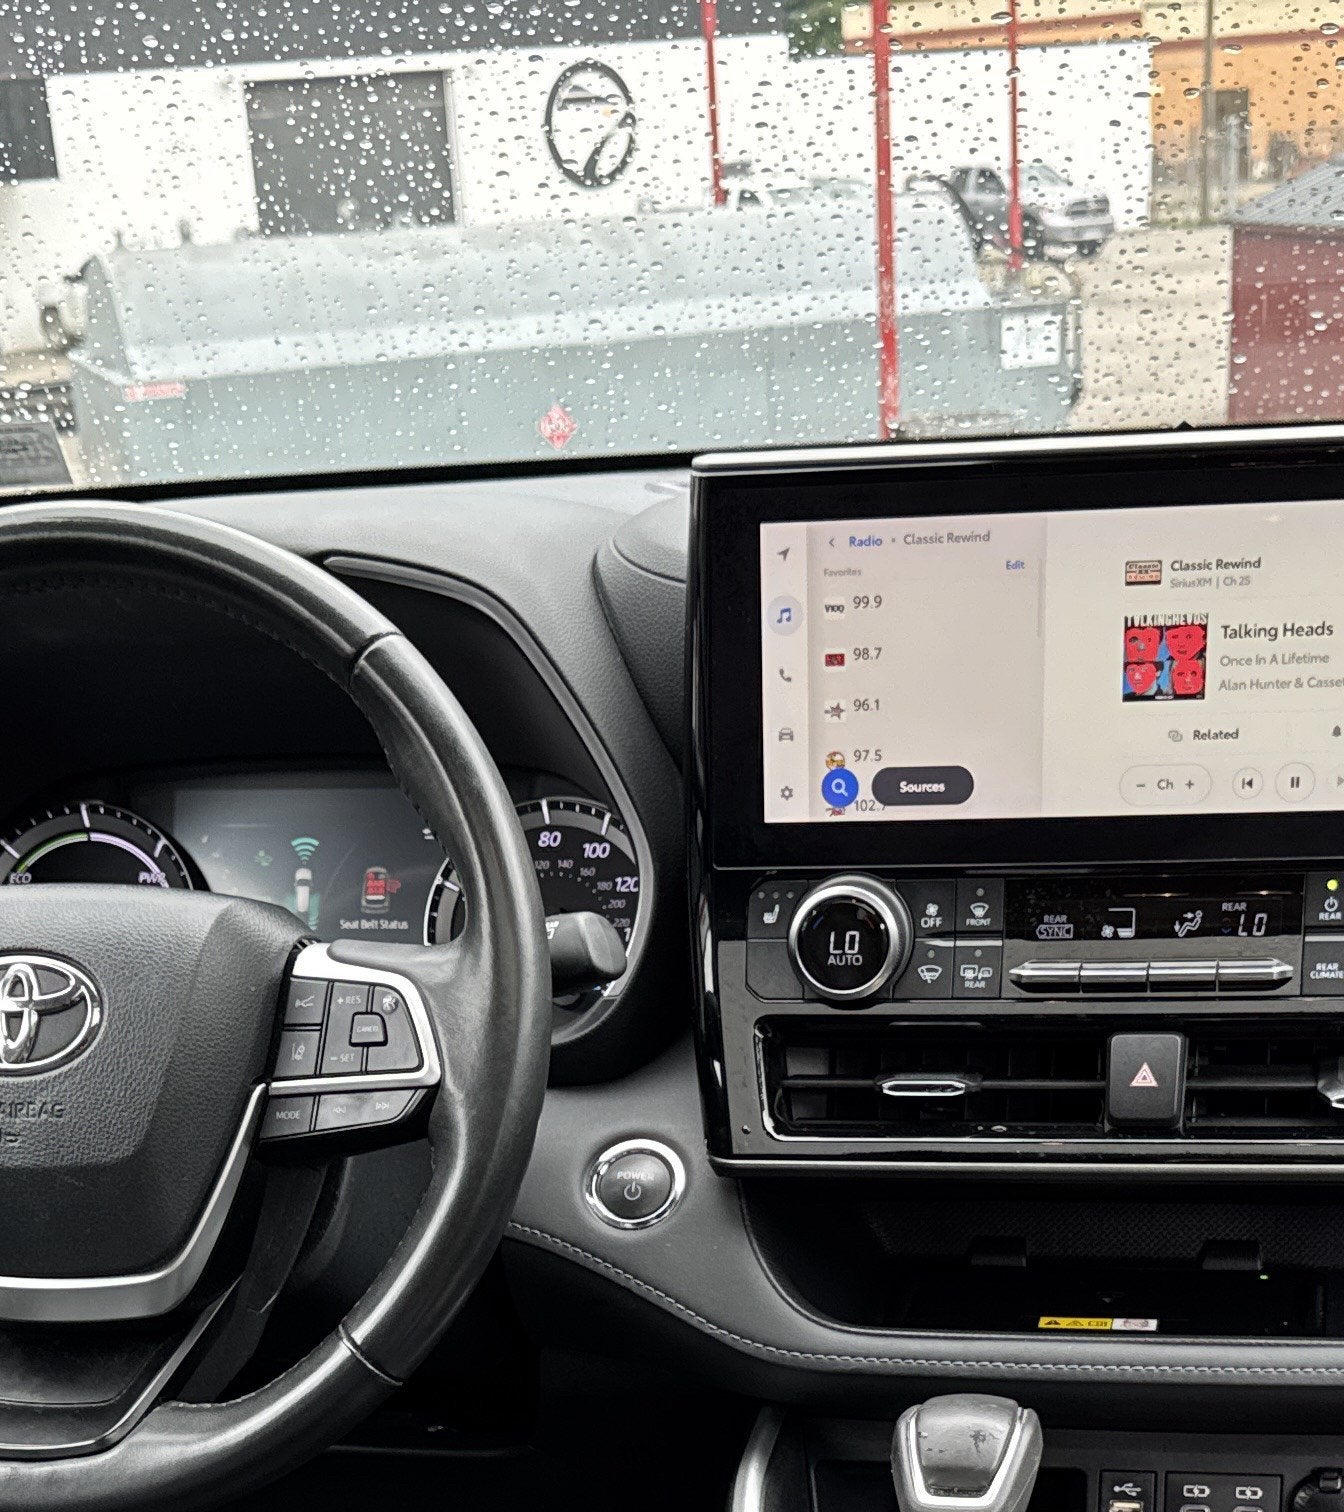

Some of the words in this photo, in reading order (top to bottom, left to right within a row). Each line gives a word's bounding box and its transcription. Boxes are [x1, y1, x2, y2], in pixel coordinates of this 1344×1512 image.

[849, 536, 882, 547] Radio
[903, 533, 944, 546] Classic
[947, 531, 991, 543] Rewind
[1006, 560, 1025, 570] Edit
[1170, 559, 1213, 571] Classic
[1216, 557, 1261, 570] Rewind
[824, 568, 862, 577] Favorites
[1170, 577, 1213, 588] SiriusXM
[1223, 576, 1236, 587] Ch
[853, 595, 882, 609] 99.9
[1221, 624, 1278, 641] Talking
[1283, 621, 1334, 637] Heads
[853, 647, 882, 661] 98.7
[1220, 655, 1253, 667] Once
[1256, 654, 1266, 665] In
[1270, 654, 1279, 665] A
[1282, 652, 1330, 665] Lifetime
[1219, 679, 1247, 691] Alan
[1250, 678, 1292, 690] Hunter
[1294, 677, 1304, 688] &
[854, 699, 880, 712] 96.1
[1193, 728, 1239, 741] Related
[854, 749, 882, 762] 97.5
[900, 781, 945, 793] Sources
[1157, 778, 1174, 790] Ch
[537, 831, 561, 847] 80
[582, 842, 610, 858] 100
[608, 899, 626, 909] 200
[1222, 902, 1247, 912] REAR
[921, 917, 942, 928] OFF
[966, 917, 991, 926] FRONT
[1043, 915, 1067, 923] REAR
[1319, 912, 1342, 921] REAR
[1039, 925, 1072, 937] SYNC
[829, 930, 860, 954] LO
[827, 954, 862, 966] AUTO
[1316, 963, 1339, 971] REAR
[1310, 971, 1344, 980] CLIMATE
[965, 980, 986, 989] REAR
[276, 1110, 300, 1120] MODE
[617, 1171, 655, 1181] POWER
